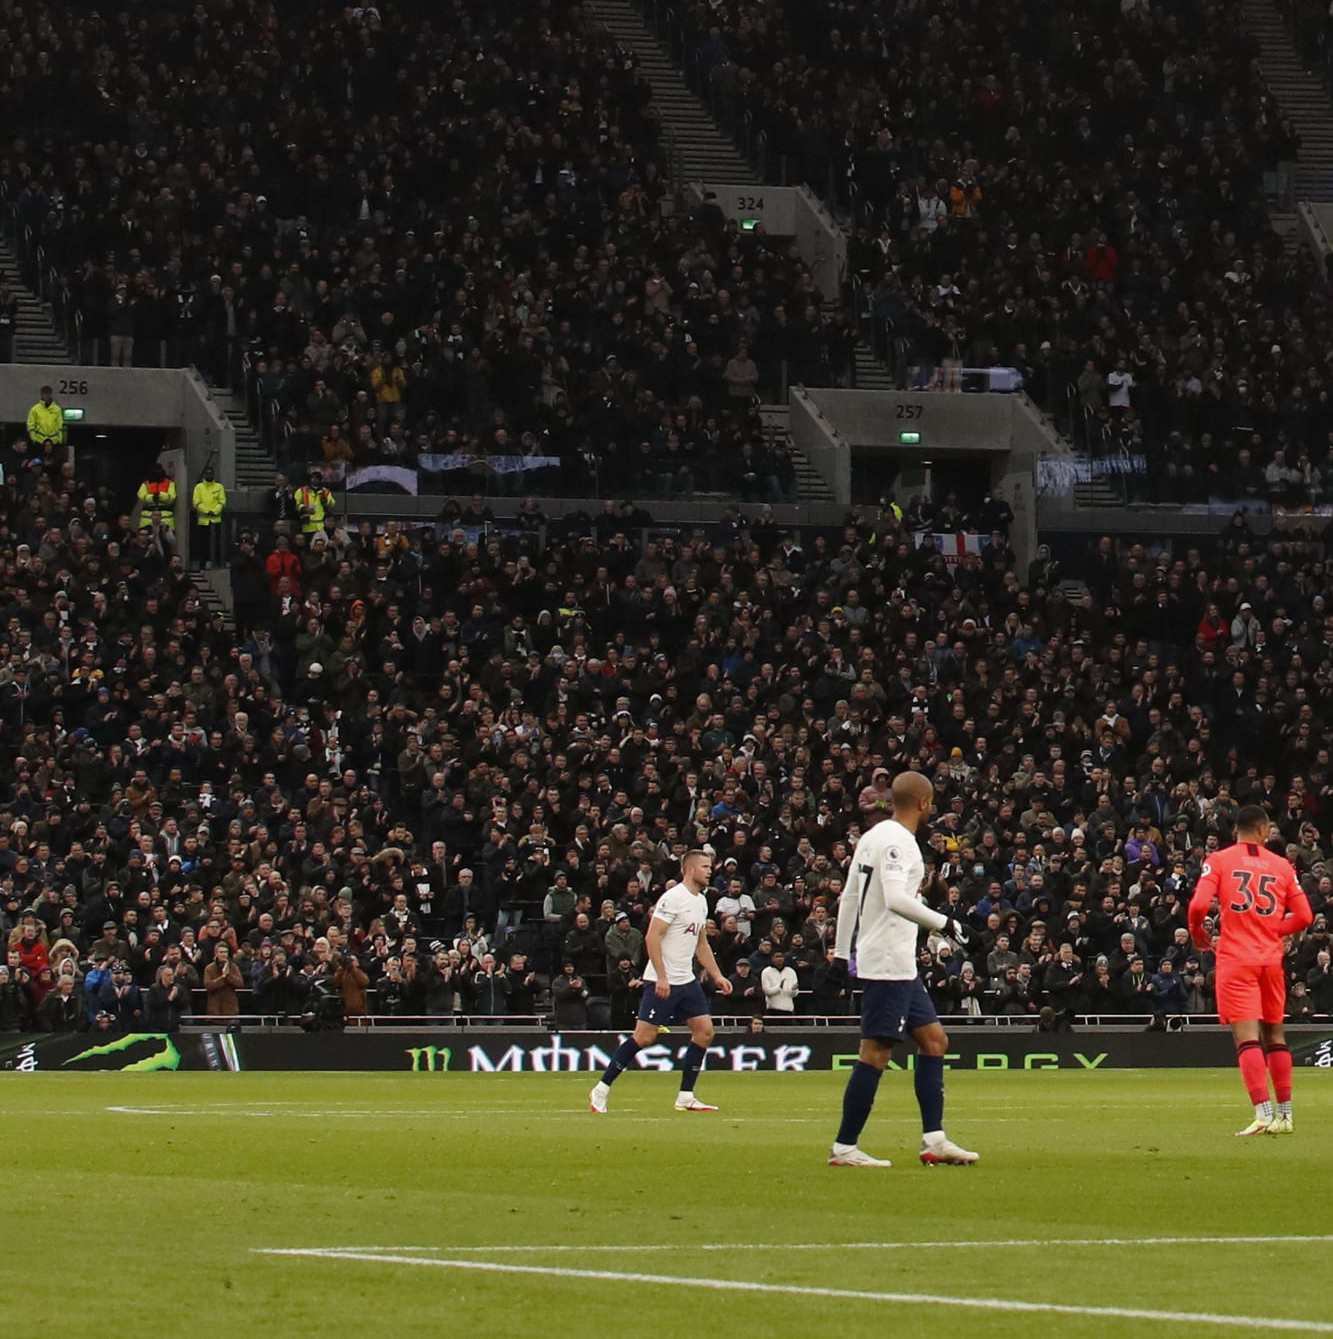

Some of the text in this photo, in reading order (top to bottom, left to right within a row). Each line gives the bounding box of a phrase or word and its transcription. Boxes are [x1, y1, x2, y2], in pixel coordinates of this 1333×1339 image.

[737, 197, 765, 210] 324
[59, 380, 89, 395] 256
[895, 404, 923, 419] 257
[858, 863, 874, 916] 7
[1230, 869, 1277, 917] 35
